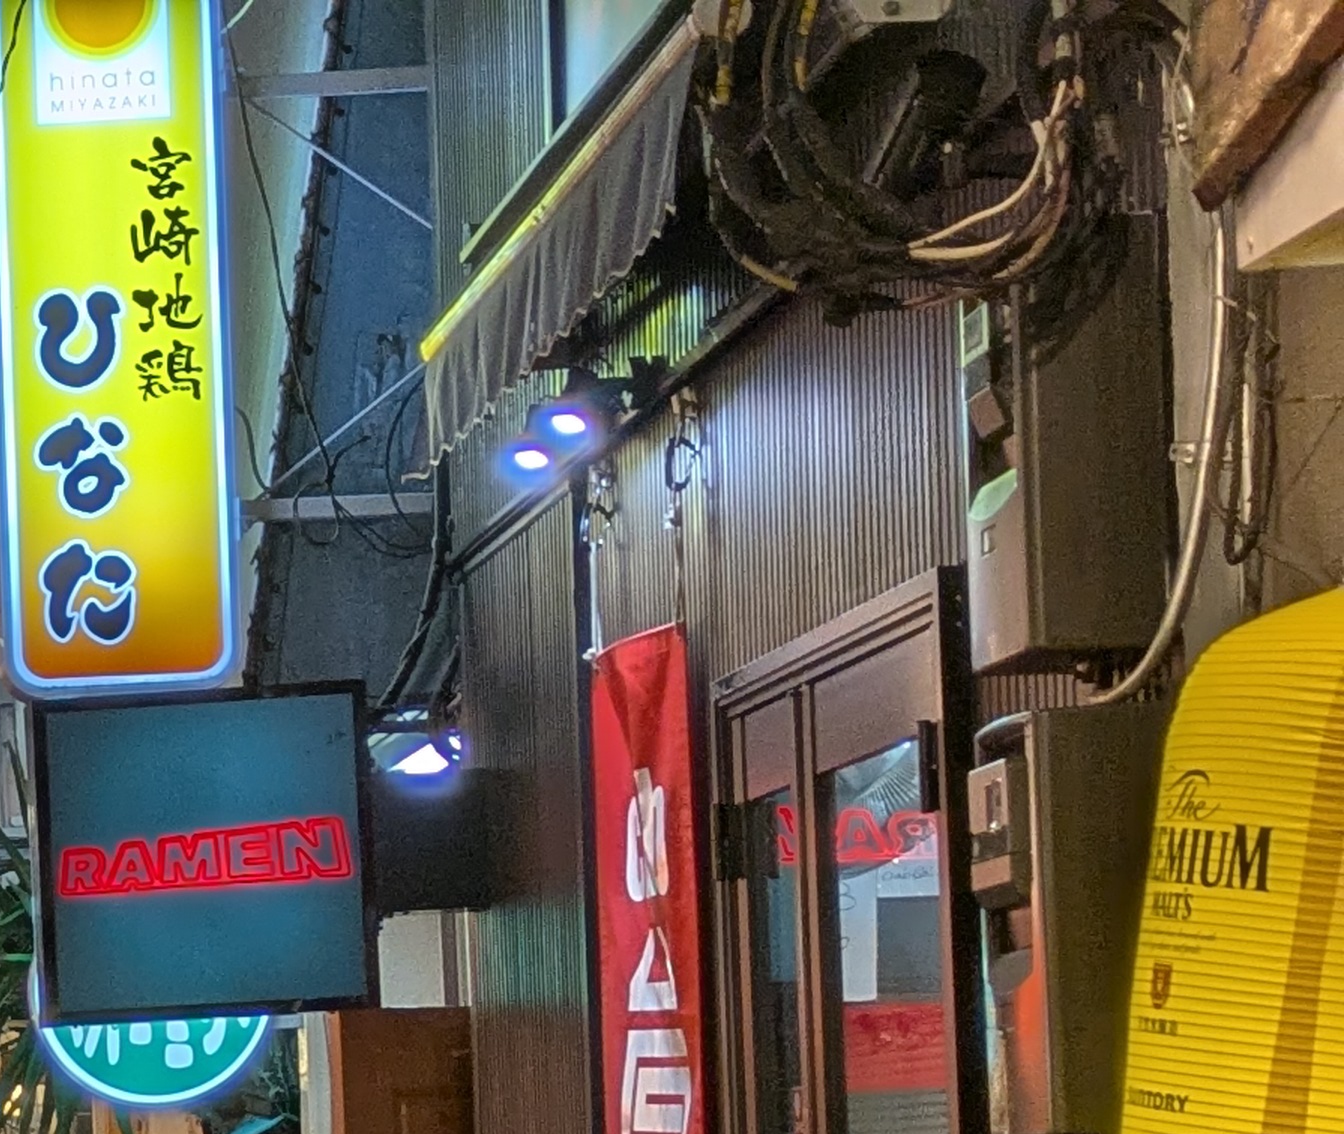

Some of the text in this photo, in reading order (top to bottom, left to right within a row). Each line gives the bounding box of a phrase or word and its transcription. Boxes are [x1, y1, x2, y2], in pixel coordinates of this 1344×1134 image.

[49, 67, 156, 93] hinata
[50, 94, 157, 113] MIYAZAKI
[131, 135, 203, 402] 宮崎地鶏
[35, 286, 137, 644] ひなた
[58, 814, 353, 897] RAMEN
